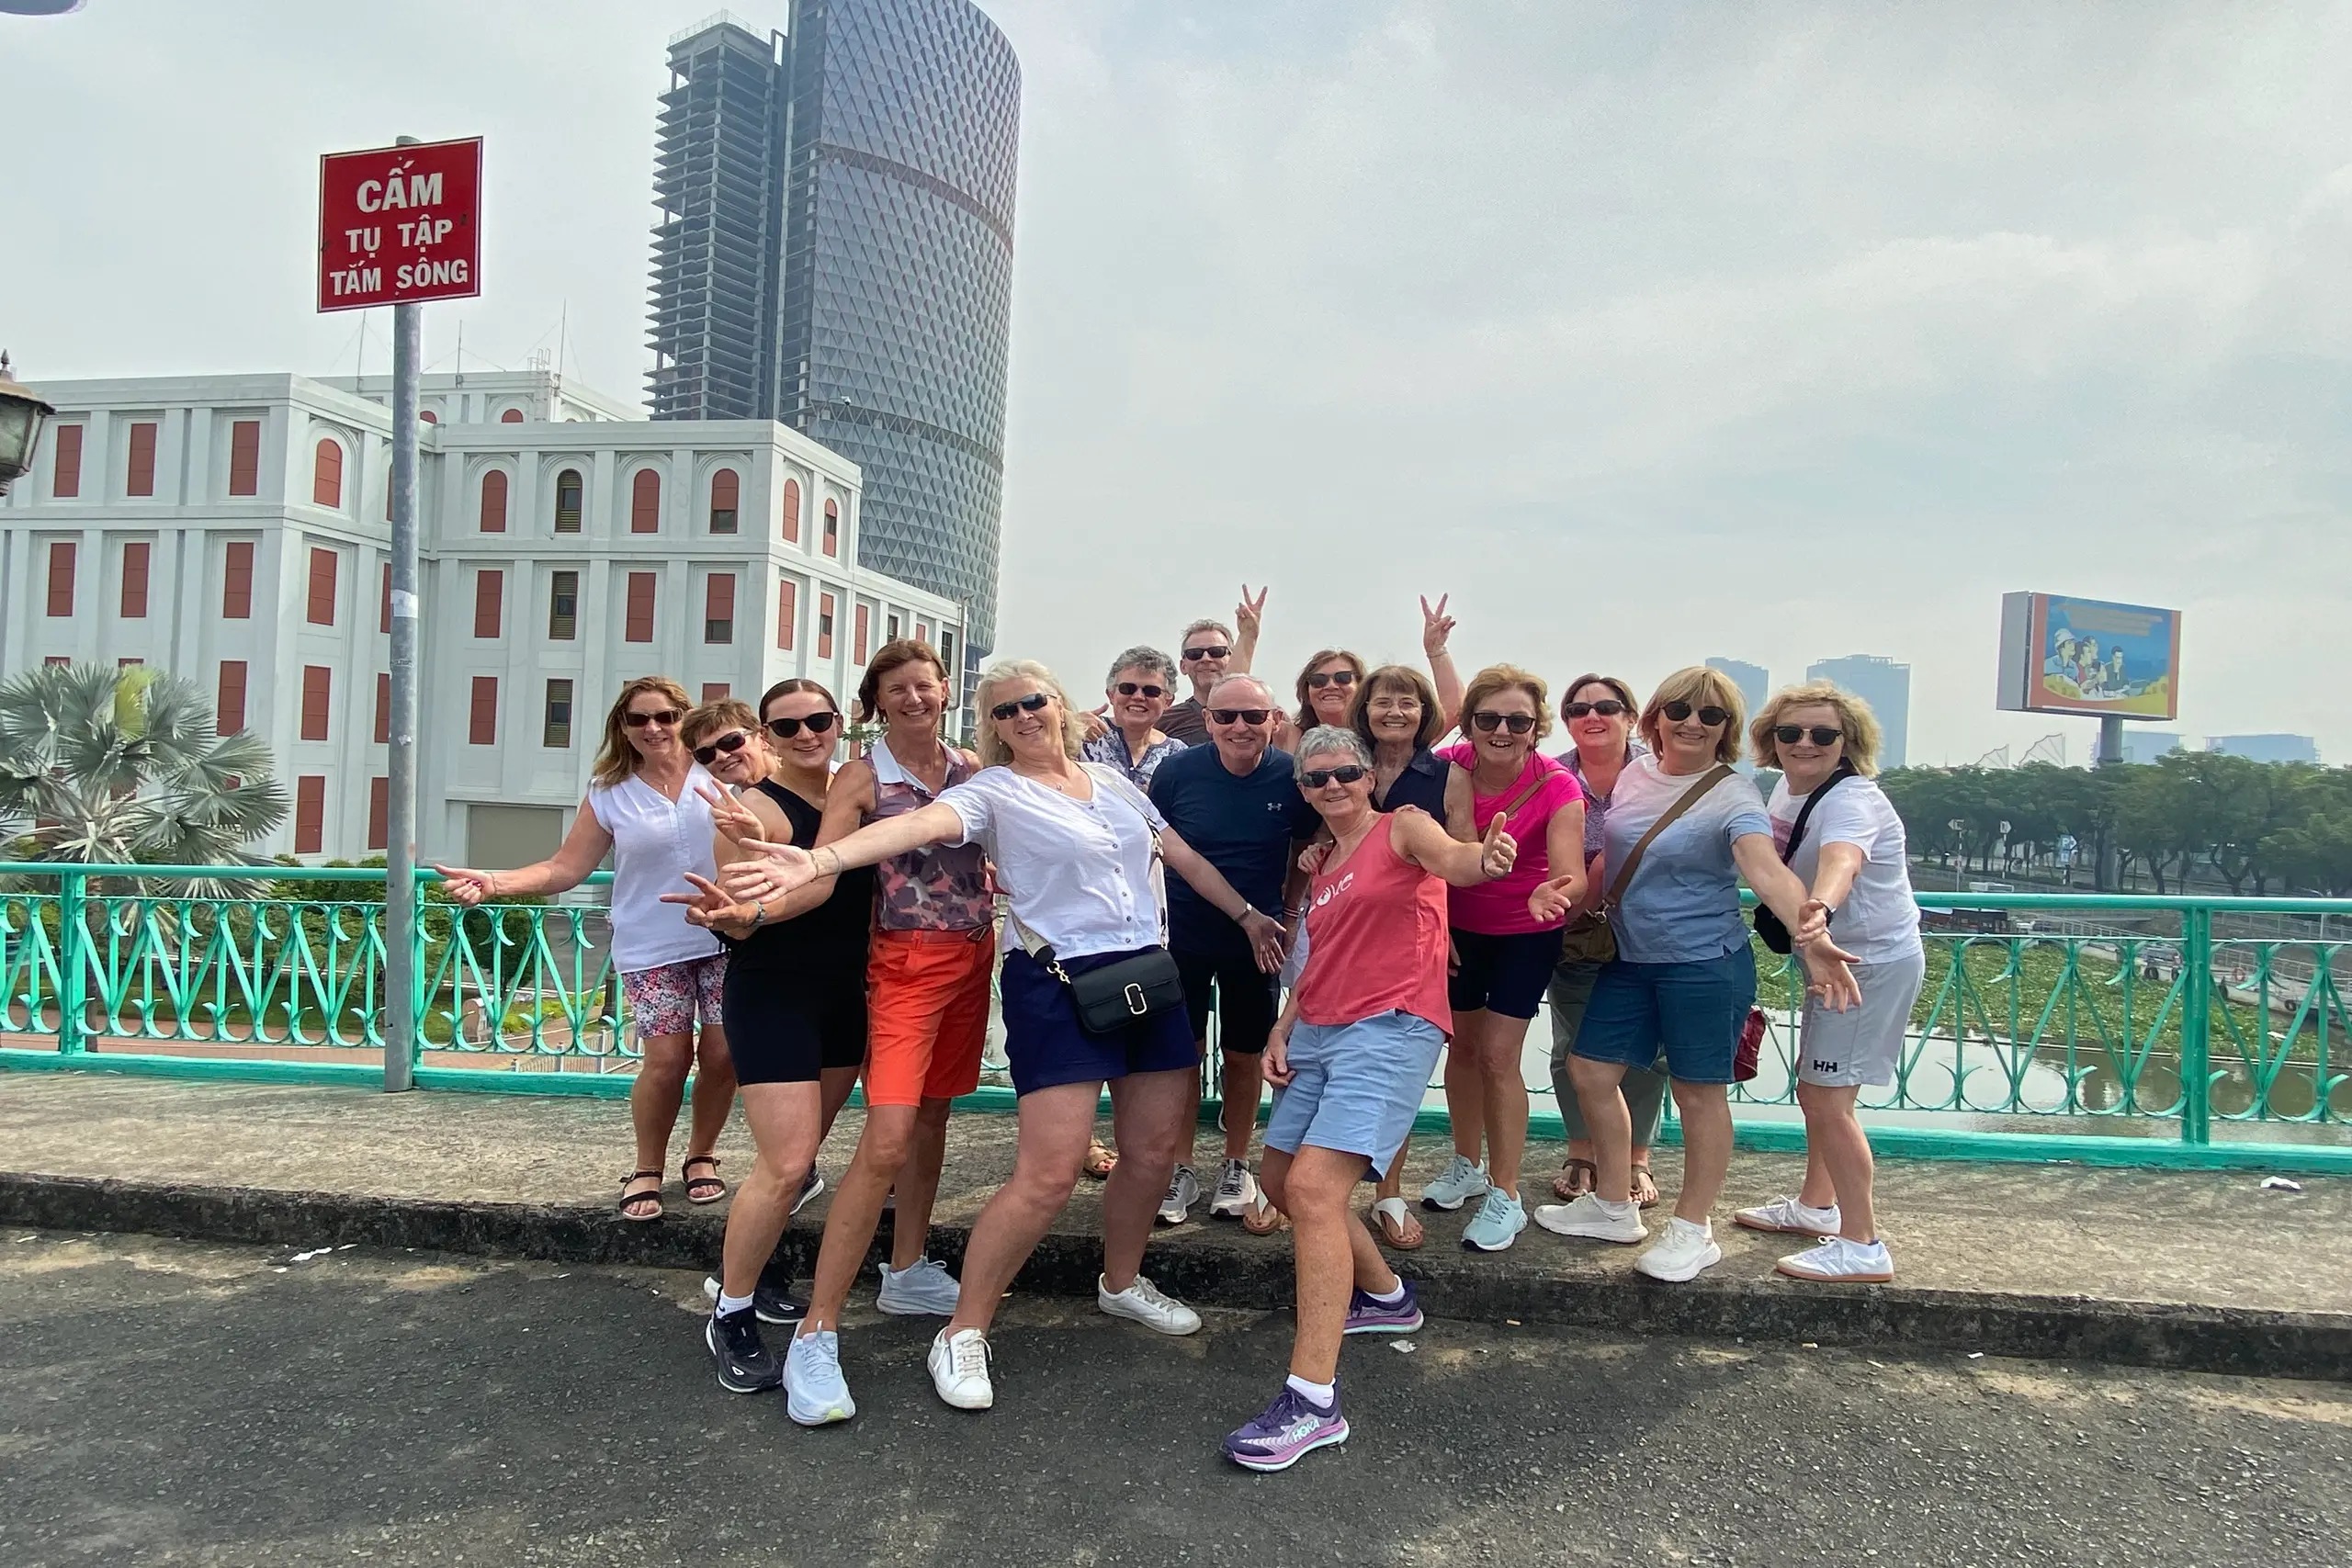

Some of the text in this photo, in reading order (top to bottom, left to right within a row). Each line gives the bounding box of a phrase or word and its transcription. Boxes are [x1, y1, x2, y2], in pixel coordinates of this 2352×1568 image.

[356, 160, 443, 213] CẤM
[345, 214, 453, 258] TỤ TẬP
[329, 256, 469, 296] TẮM SÔNG
[1814, 1059, 1838, 1073] HH
[1292, 1418, 1320, 1442] HOKA
